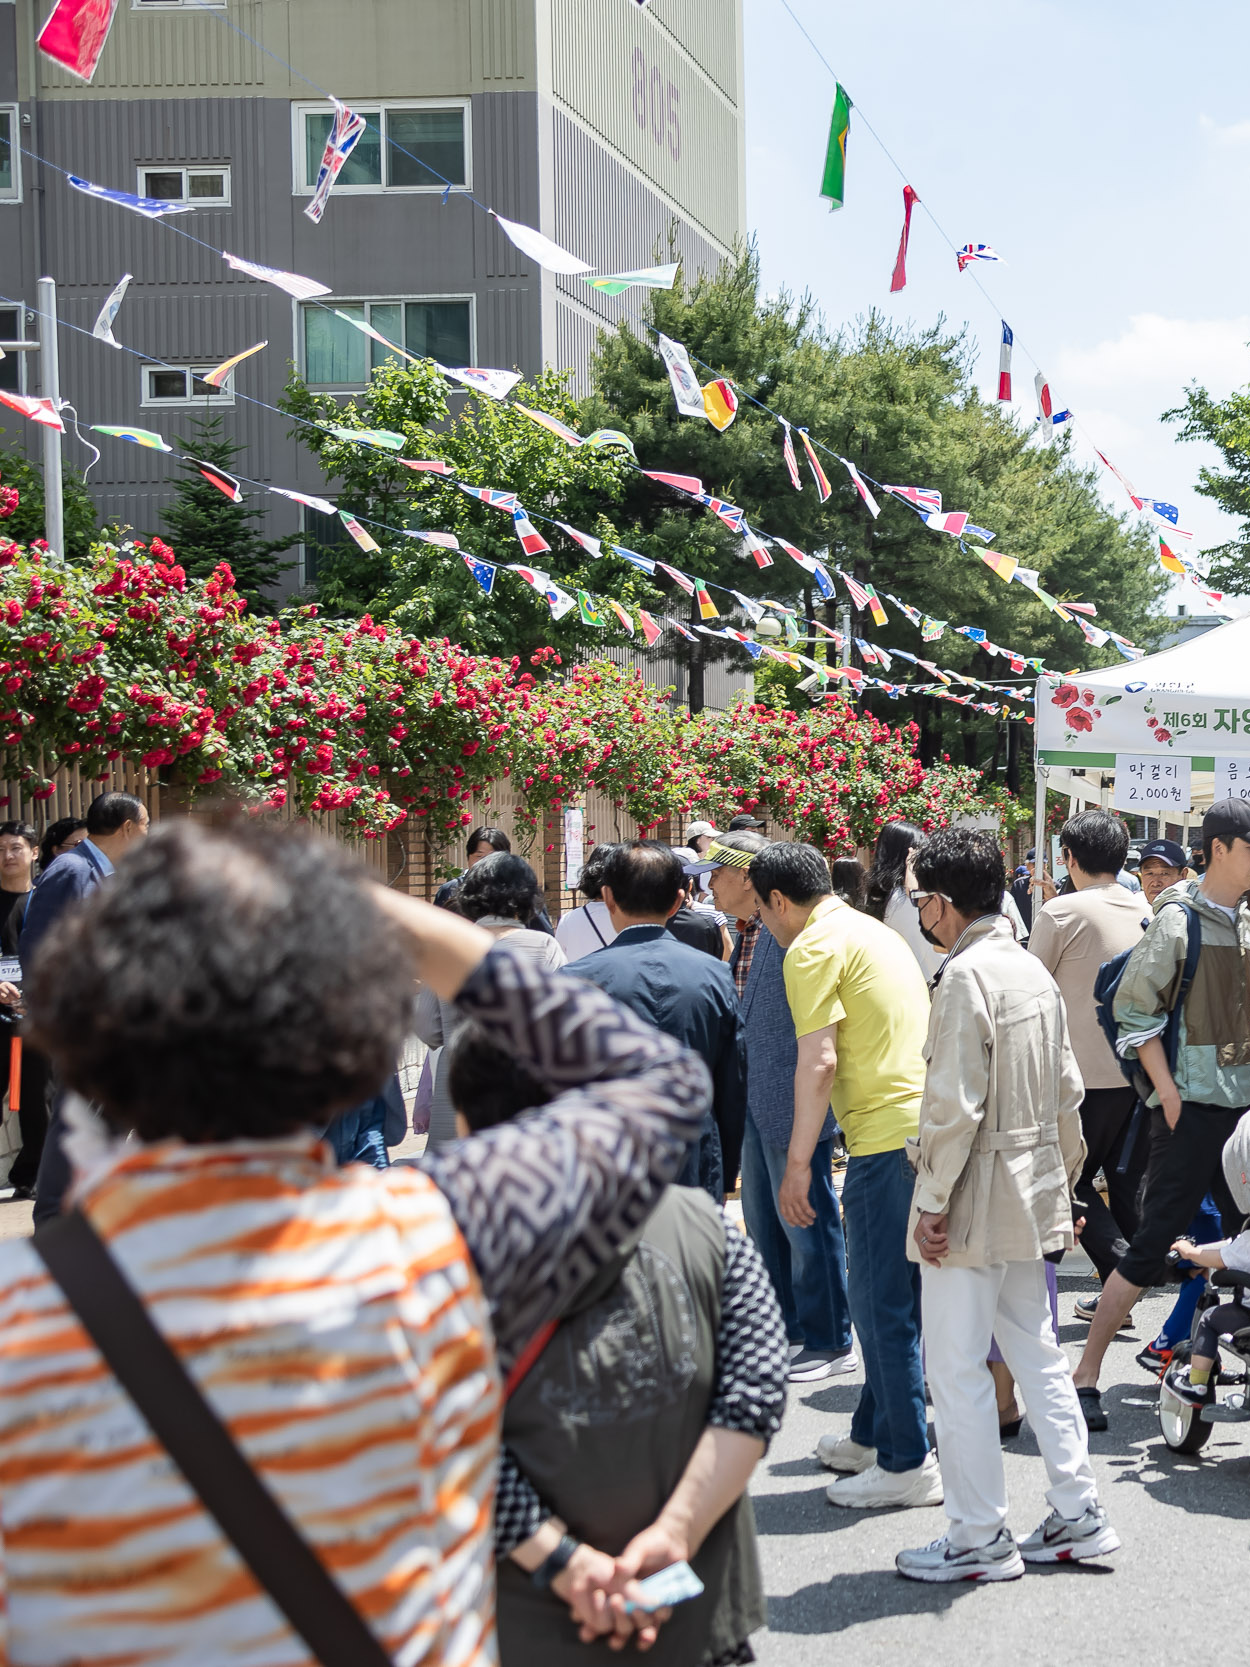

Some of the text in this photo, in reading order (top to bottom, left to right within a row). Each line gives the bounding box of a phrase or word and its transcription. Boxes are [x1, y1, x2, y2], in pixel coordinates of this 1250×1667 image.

[632, 46, 680, 162] 805
[1163, 711, 1207, 729] 제6회
[1129, 763, 1178, 780] 막걸리
